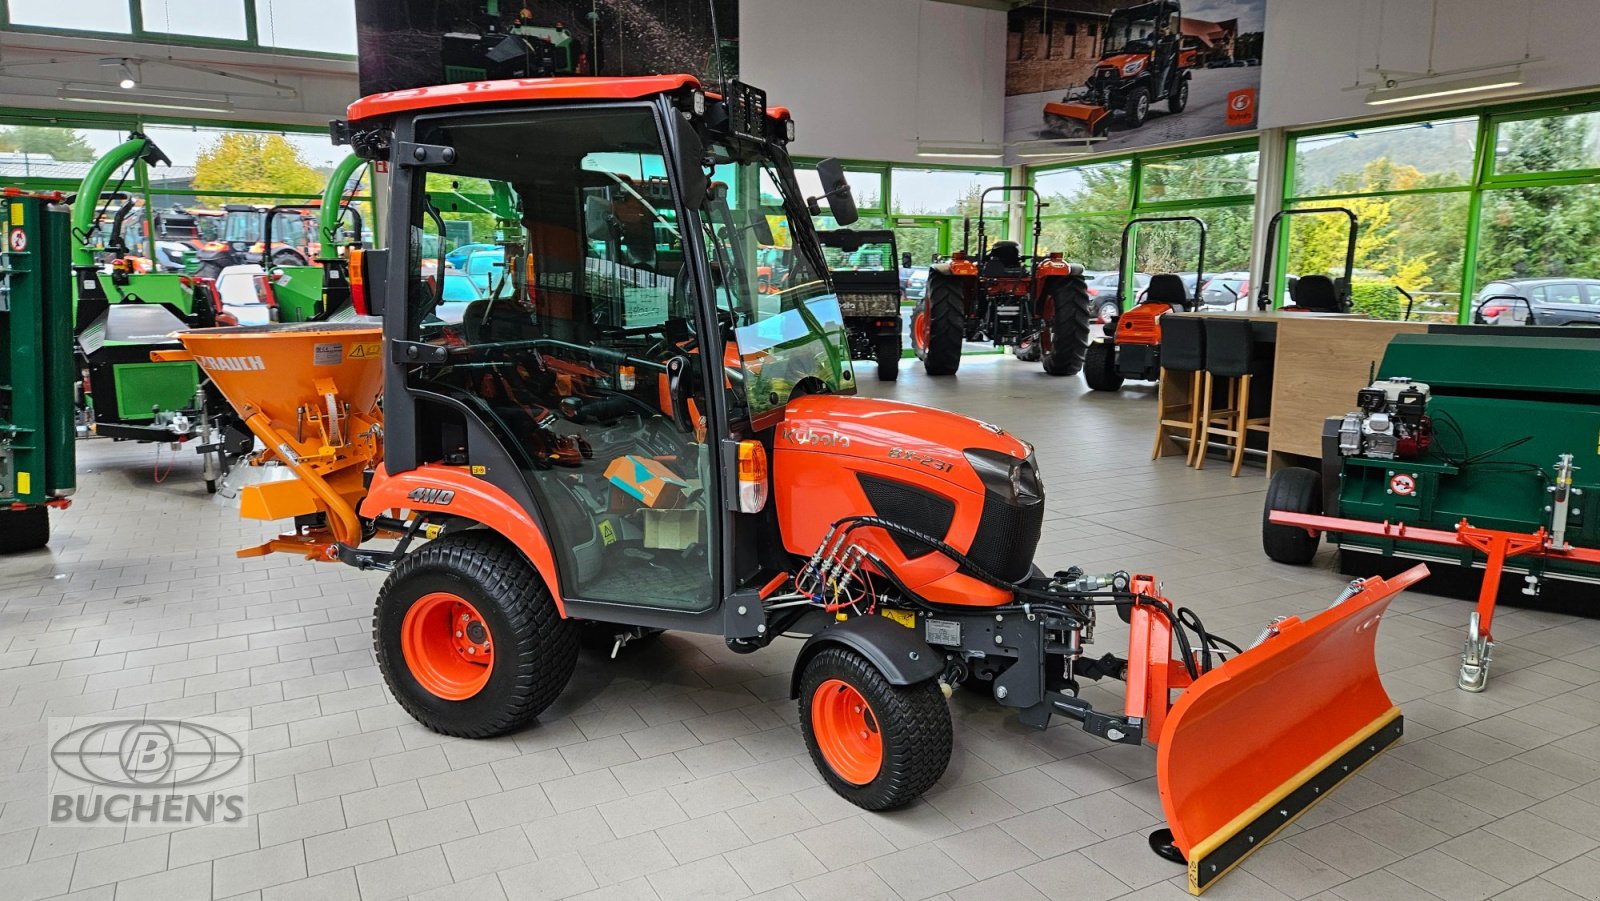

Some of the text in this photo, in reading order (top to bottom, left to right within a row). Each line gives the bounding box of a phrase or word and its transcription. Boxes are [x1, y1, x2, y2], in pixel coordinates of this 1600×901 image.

[205, 355, 266, 370] RAUCH
[782, 428, 850, 447] Kubota
[888, 447, 953, 473] BX-231
[407, 487, 456, 505] 4WD
